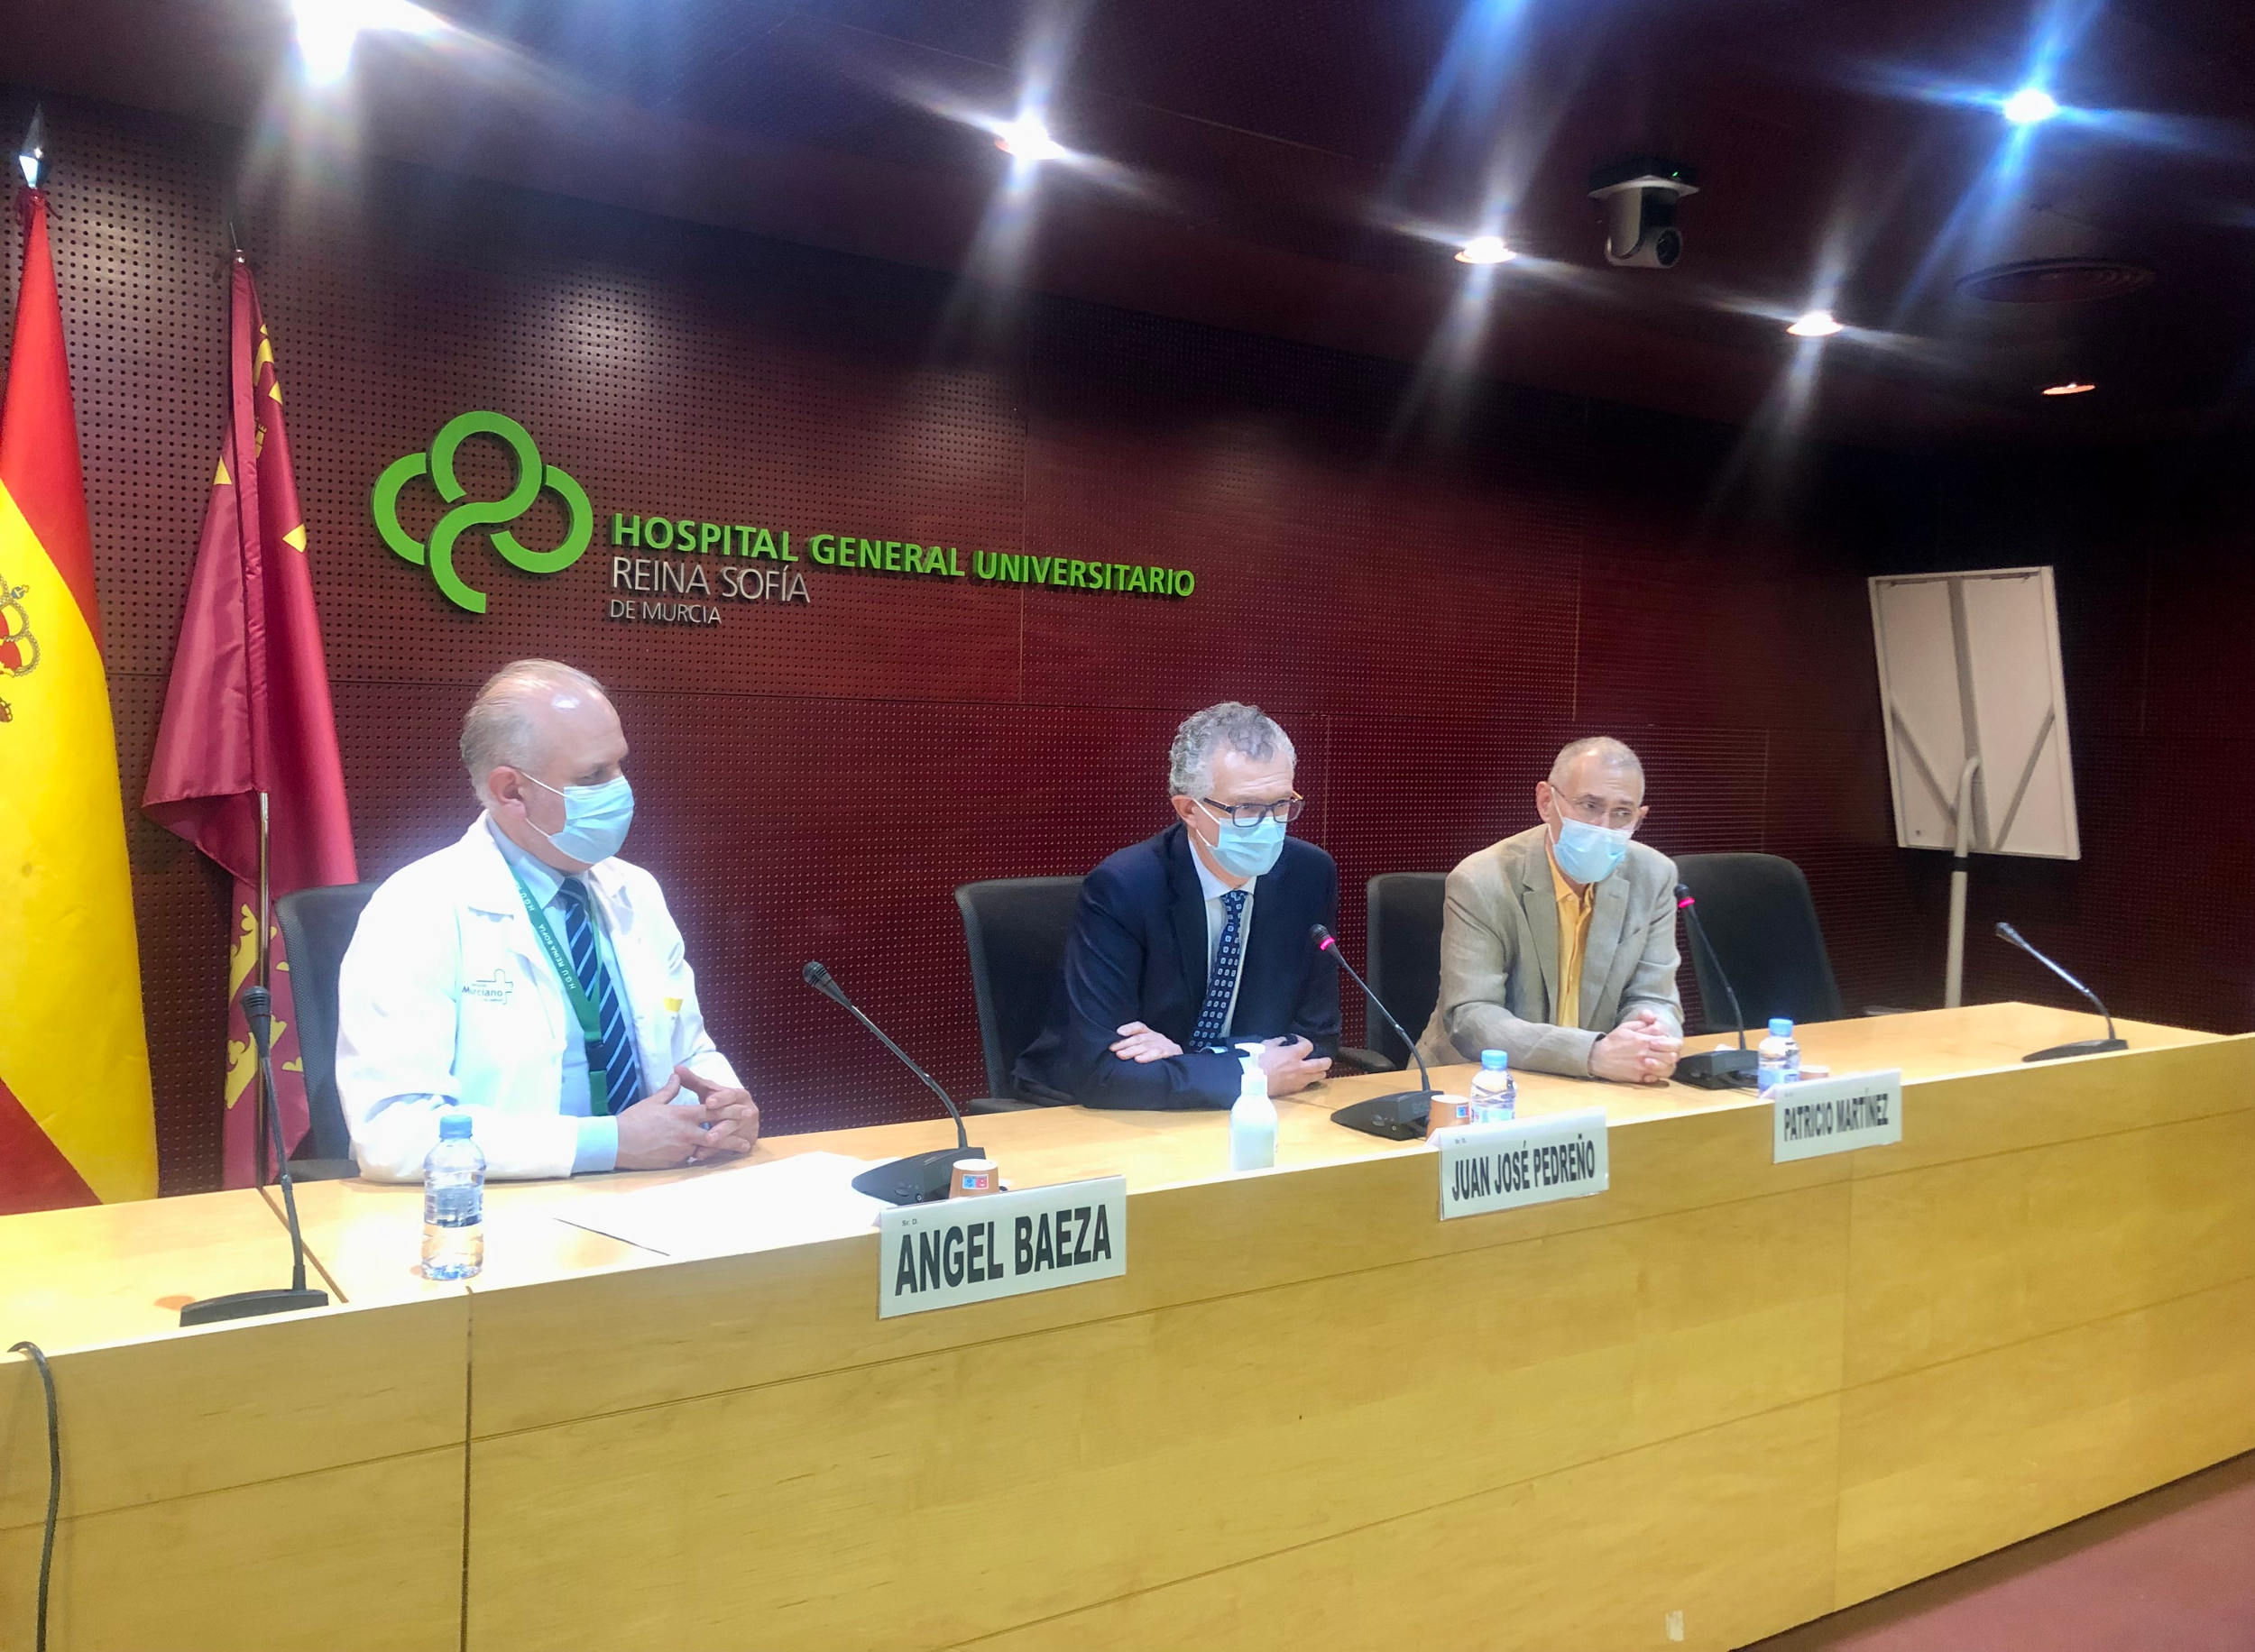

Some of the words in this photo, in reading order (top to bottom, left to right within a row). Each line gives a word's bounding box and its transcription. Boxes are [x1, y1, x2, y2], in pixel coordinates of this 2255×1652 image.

[613, 512, 799, 562] HOSPITAL
[811, 534, 965, 577] GENERAL
[973, 549, 1195, 597] UNIVERSITARIO
[613, 555, 711, 595] REINA
[720, 564, 811, 603] SOFÍA
[610, 599, 636, 620] DE
[642, 601, 723, 624] MURCIA
[1784, 1101, 1833, 1142] PATRICIO
[1452, 1156, 1490, 1201] JUAN
[1495, 1141, 1530, 1194] JOSÉ
[1534, 1133, 1595, 1187] PEDREÑO
[895, 1221, 1004, 1296] ANGEL
[1015, 1204, 1112, 1275] BAEZA
